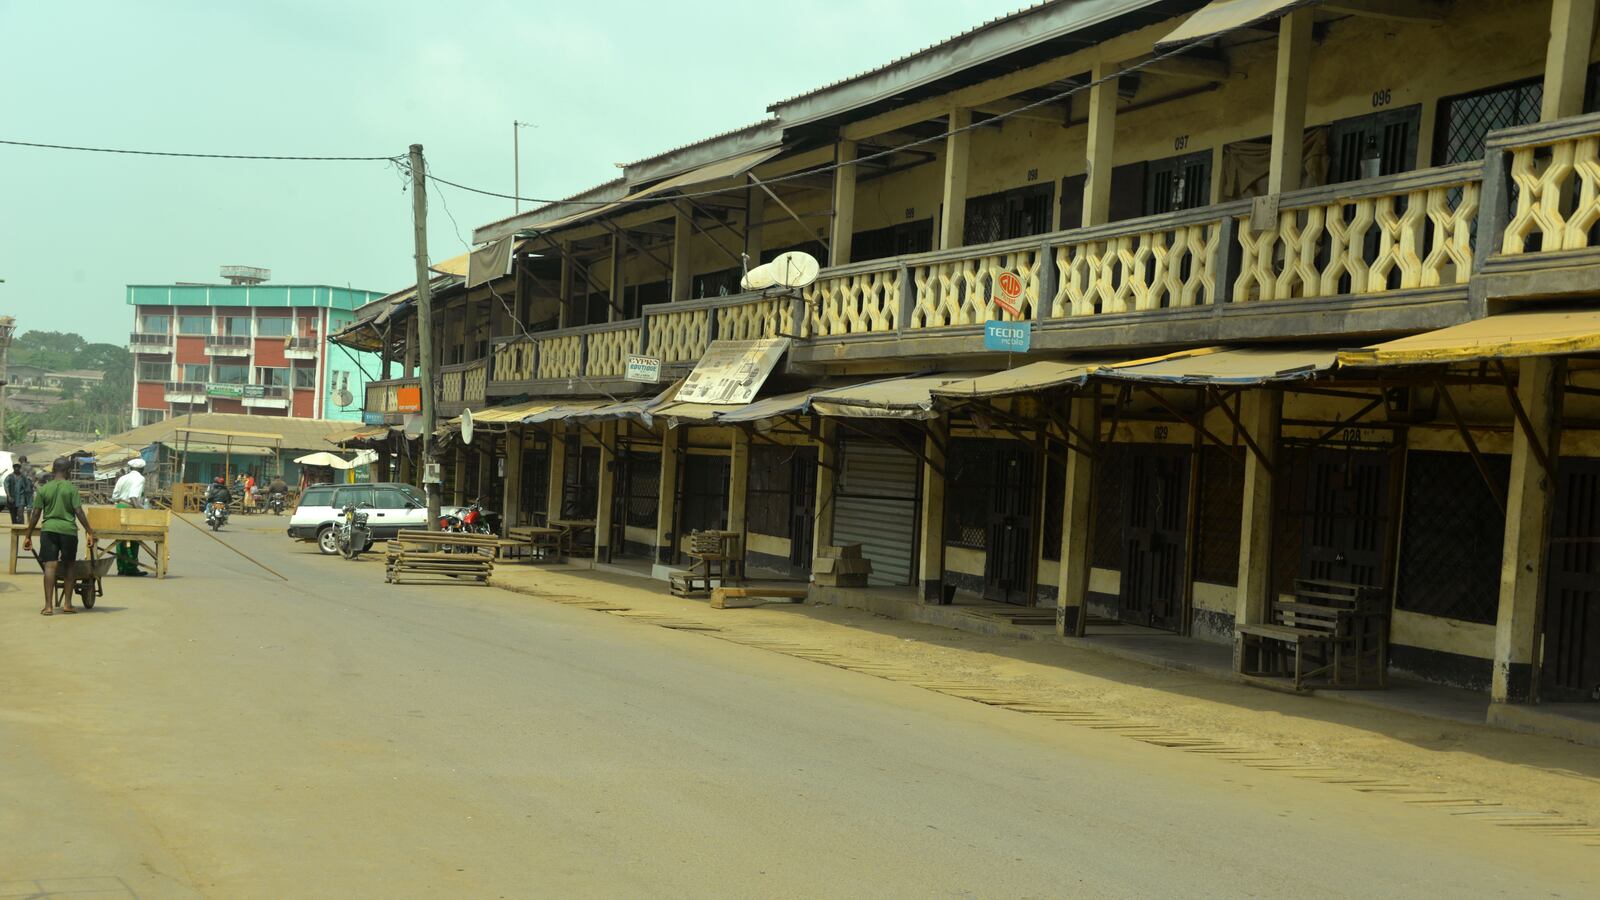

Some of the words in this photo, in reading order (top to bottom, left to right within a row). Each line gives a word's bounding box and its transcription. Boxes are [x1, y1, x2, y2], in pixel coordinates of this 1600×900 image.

[1372, 88, 1391, 107] 096
[1175, 135, 1190, 150] 097
[988, 326, 1024, 339] TECNO
[1153, 425, 1169, 440] 029
